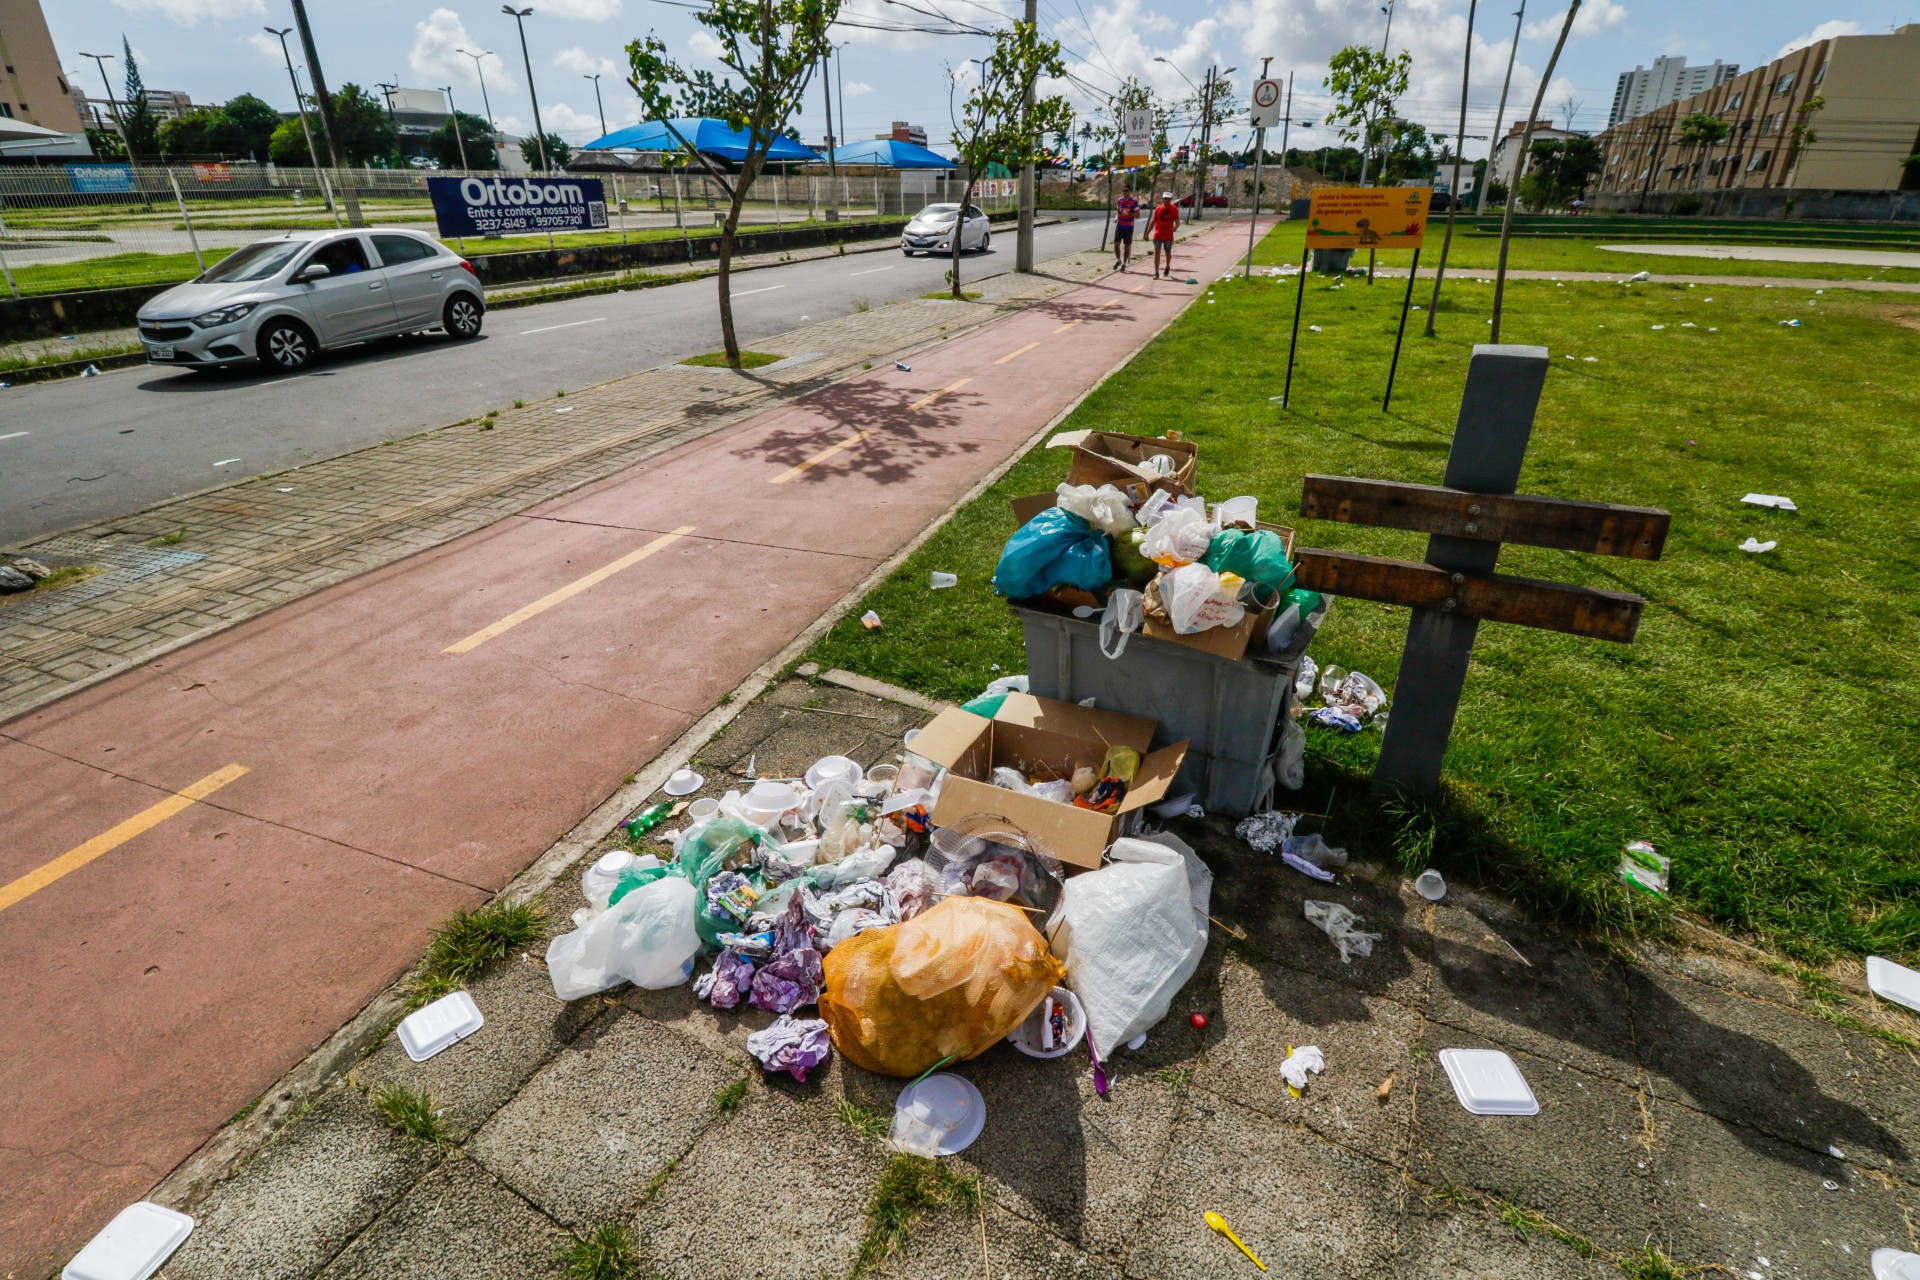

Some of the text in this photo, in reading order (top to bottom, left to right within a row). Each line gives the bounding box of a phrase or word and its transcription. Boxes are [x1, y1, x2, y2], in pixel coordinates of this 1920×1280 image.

[460, 178, 584, 206] Ortobom
[467, 207, 496, 218] Entre
[504, 206, 542, 218] conheça
[543, 206, 569, 215] nossa
[570, 204, 585, 216] loja
[475, 215, 582, 230] 3237-6149 99705-7301
